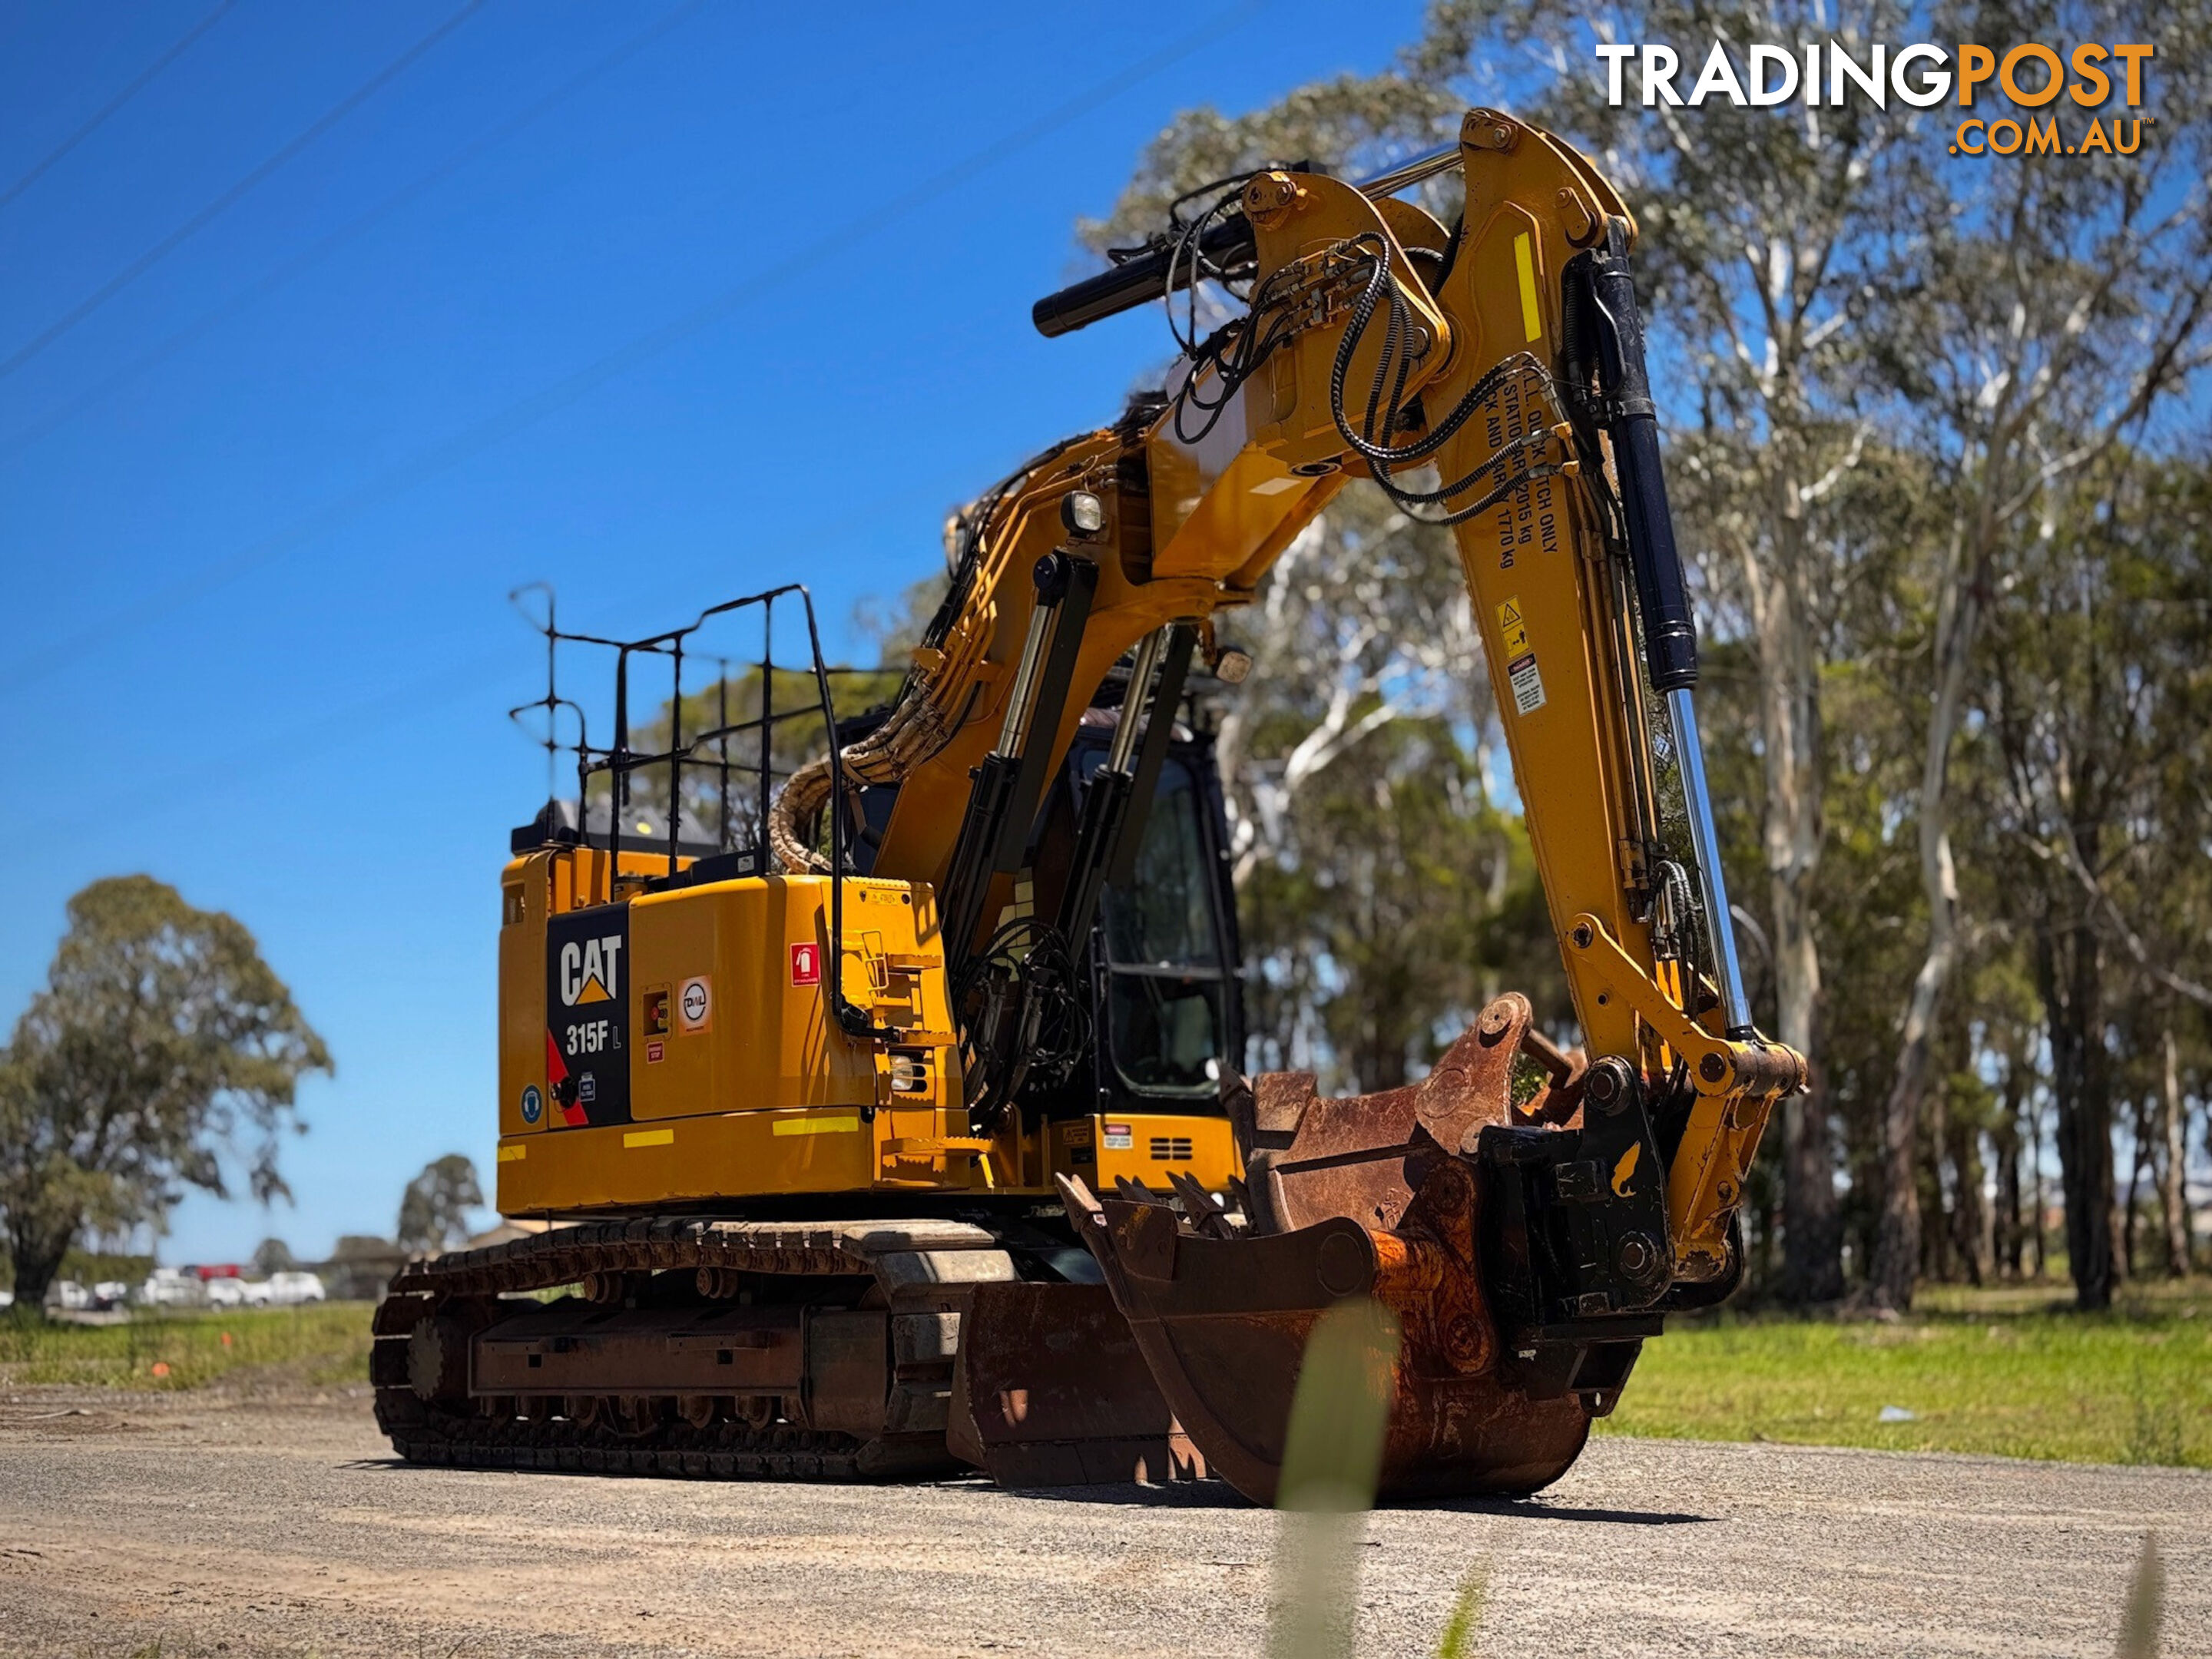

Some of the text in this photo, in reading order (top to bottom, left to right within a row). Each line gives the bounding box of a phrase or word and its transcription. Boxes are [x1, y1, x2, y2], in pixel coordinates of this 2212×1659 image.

[1485, 416, 1502, 449] AND
[1504, 383, 1534, 545] STATIOAR 2015 kg
[1534, 461, 1552, 511] TCH
[1497, 508, 1514, 547] 1770
[1539, 513, 1558, 553] ONLY
[1499, 548, 1516, 570] kg
[561, 934, 622, 1007] CAT
[566, 1019, 609, 1056] 315F
